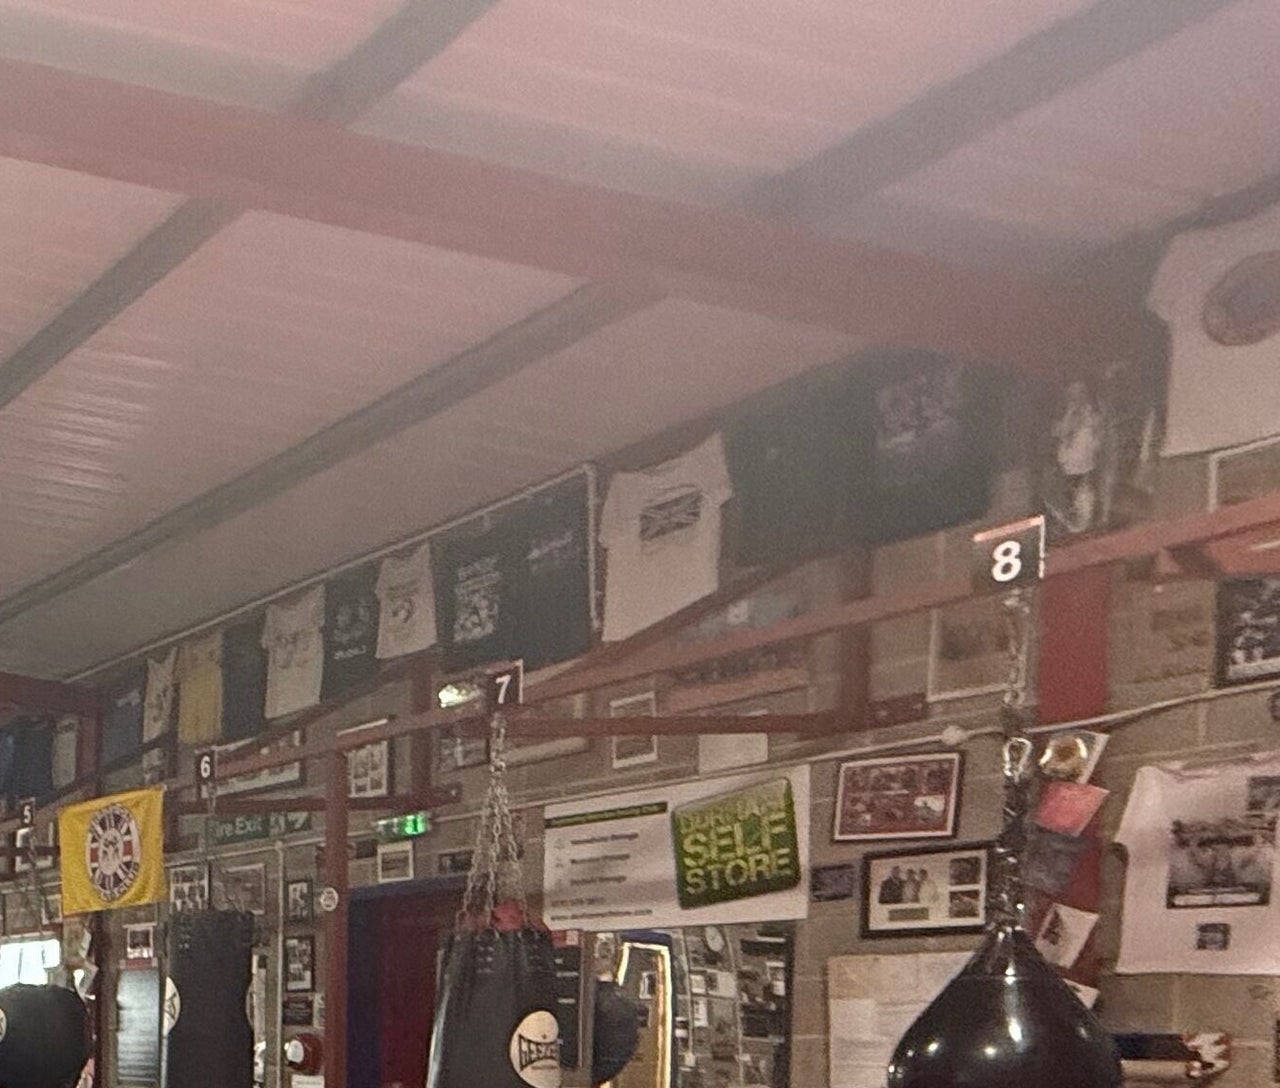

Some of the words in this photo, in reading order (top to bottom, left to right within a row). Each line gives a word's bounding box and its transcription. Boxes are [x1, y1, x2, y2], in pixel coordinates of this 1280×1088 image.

[992, 540, 1022, 582] 8
[495, 674, 511, 705] 7
[200, 755, 211, 779] 6
[23, 805, 32, 824] 5
[683, 811, 788, 866] SELF
[686, 847, 793, 895] STORE
